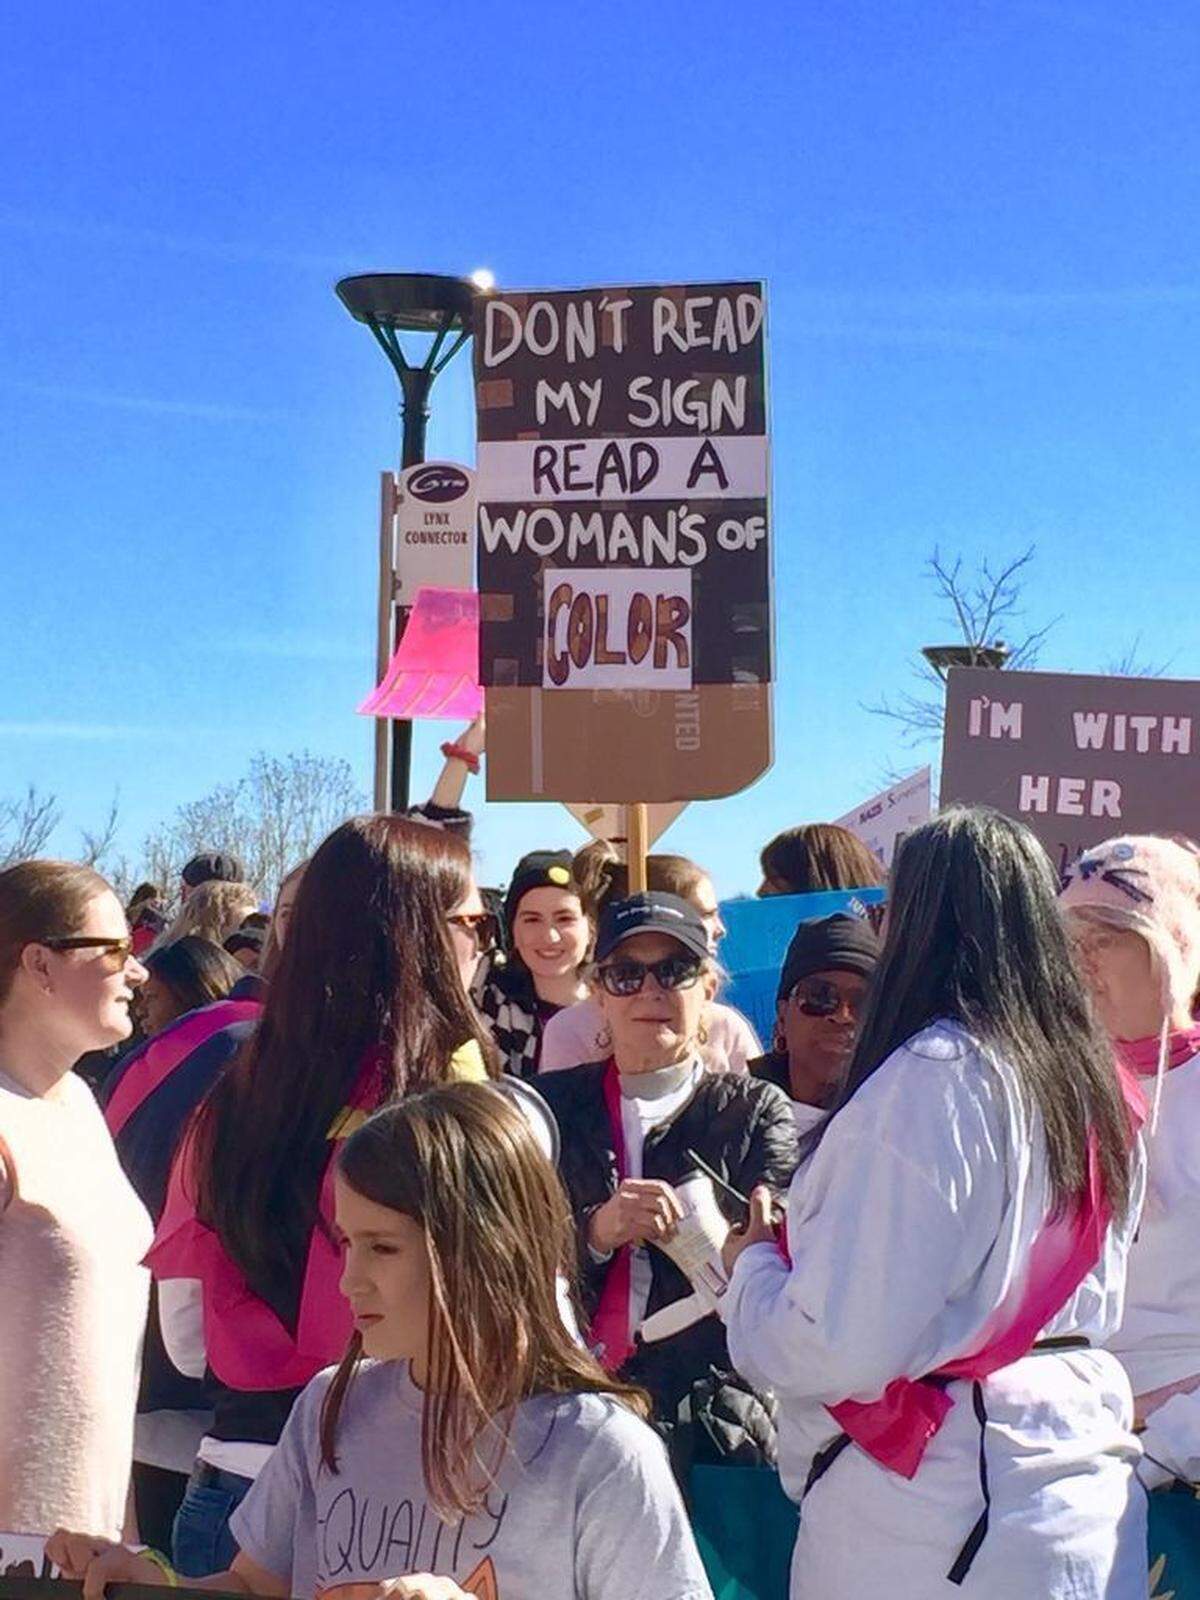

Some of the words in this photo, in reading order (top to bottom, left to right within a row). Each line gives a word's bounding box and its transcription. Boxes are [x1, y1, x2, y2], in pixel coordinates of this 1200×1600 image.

[484, 296, 633, 368] DON'T
[653, 294, 765, 354] READ
[536, 378, 602, 427] MY
[628, 376, 747, 431] SIGN
[533, 441, 660, 497] READ
[686, 439, 729, 490] A
[405, 531, 467, 545] CONNECTOR
[424, 512, 450, 526] LYNX
[479, 505, 707, 566] WOMAN'S
[717, 517, 766, 551] OF
[548, 583, 690, 686] COLOR
[968, 695, 1023, 739] I'M
[1073, 711, 1192, 754] WITH
[1018, 775, 1122, 818] HER
